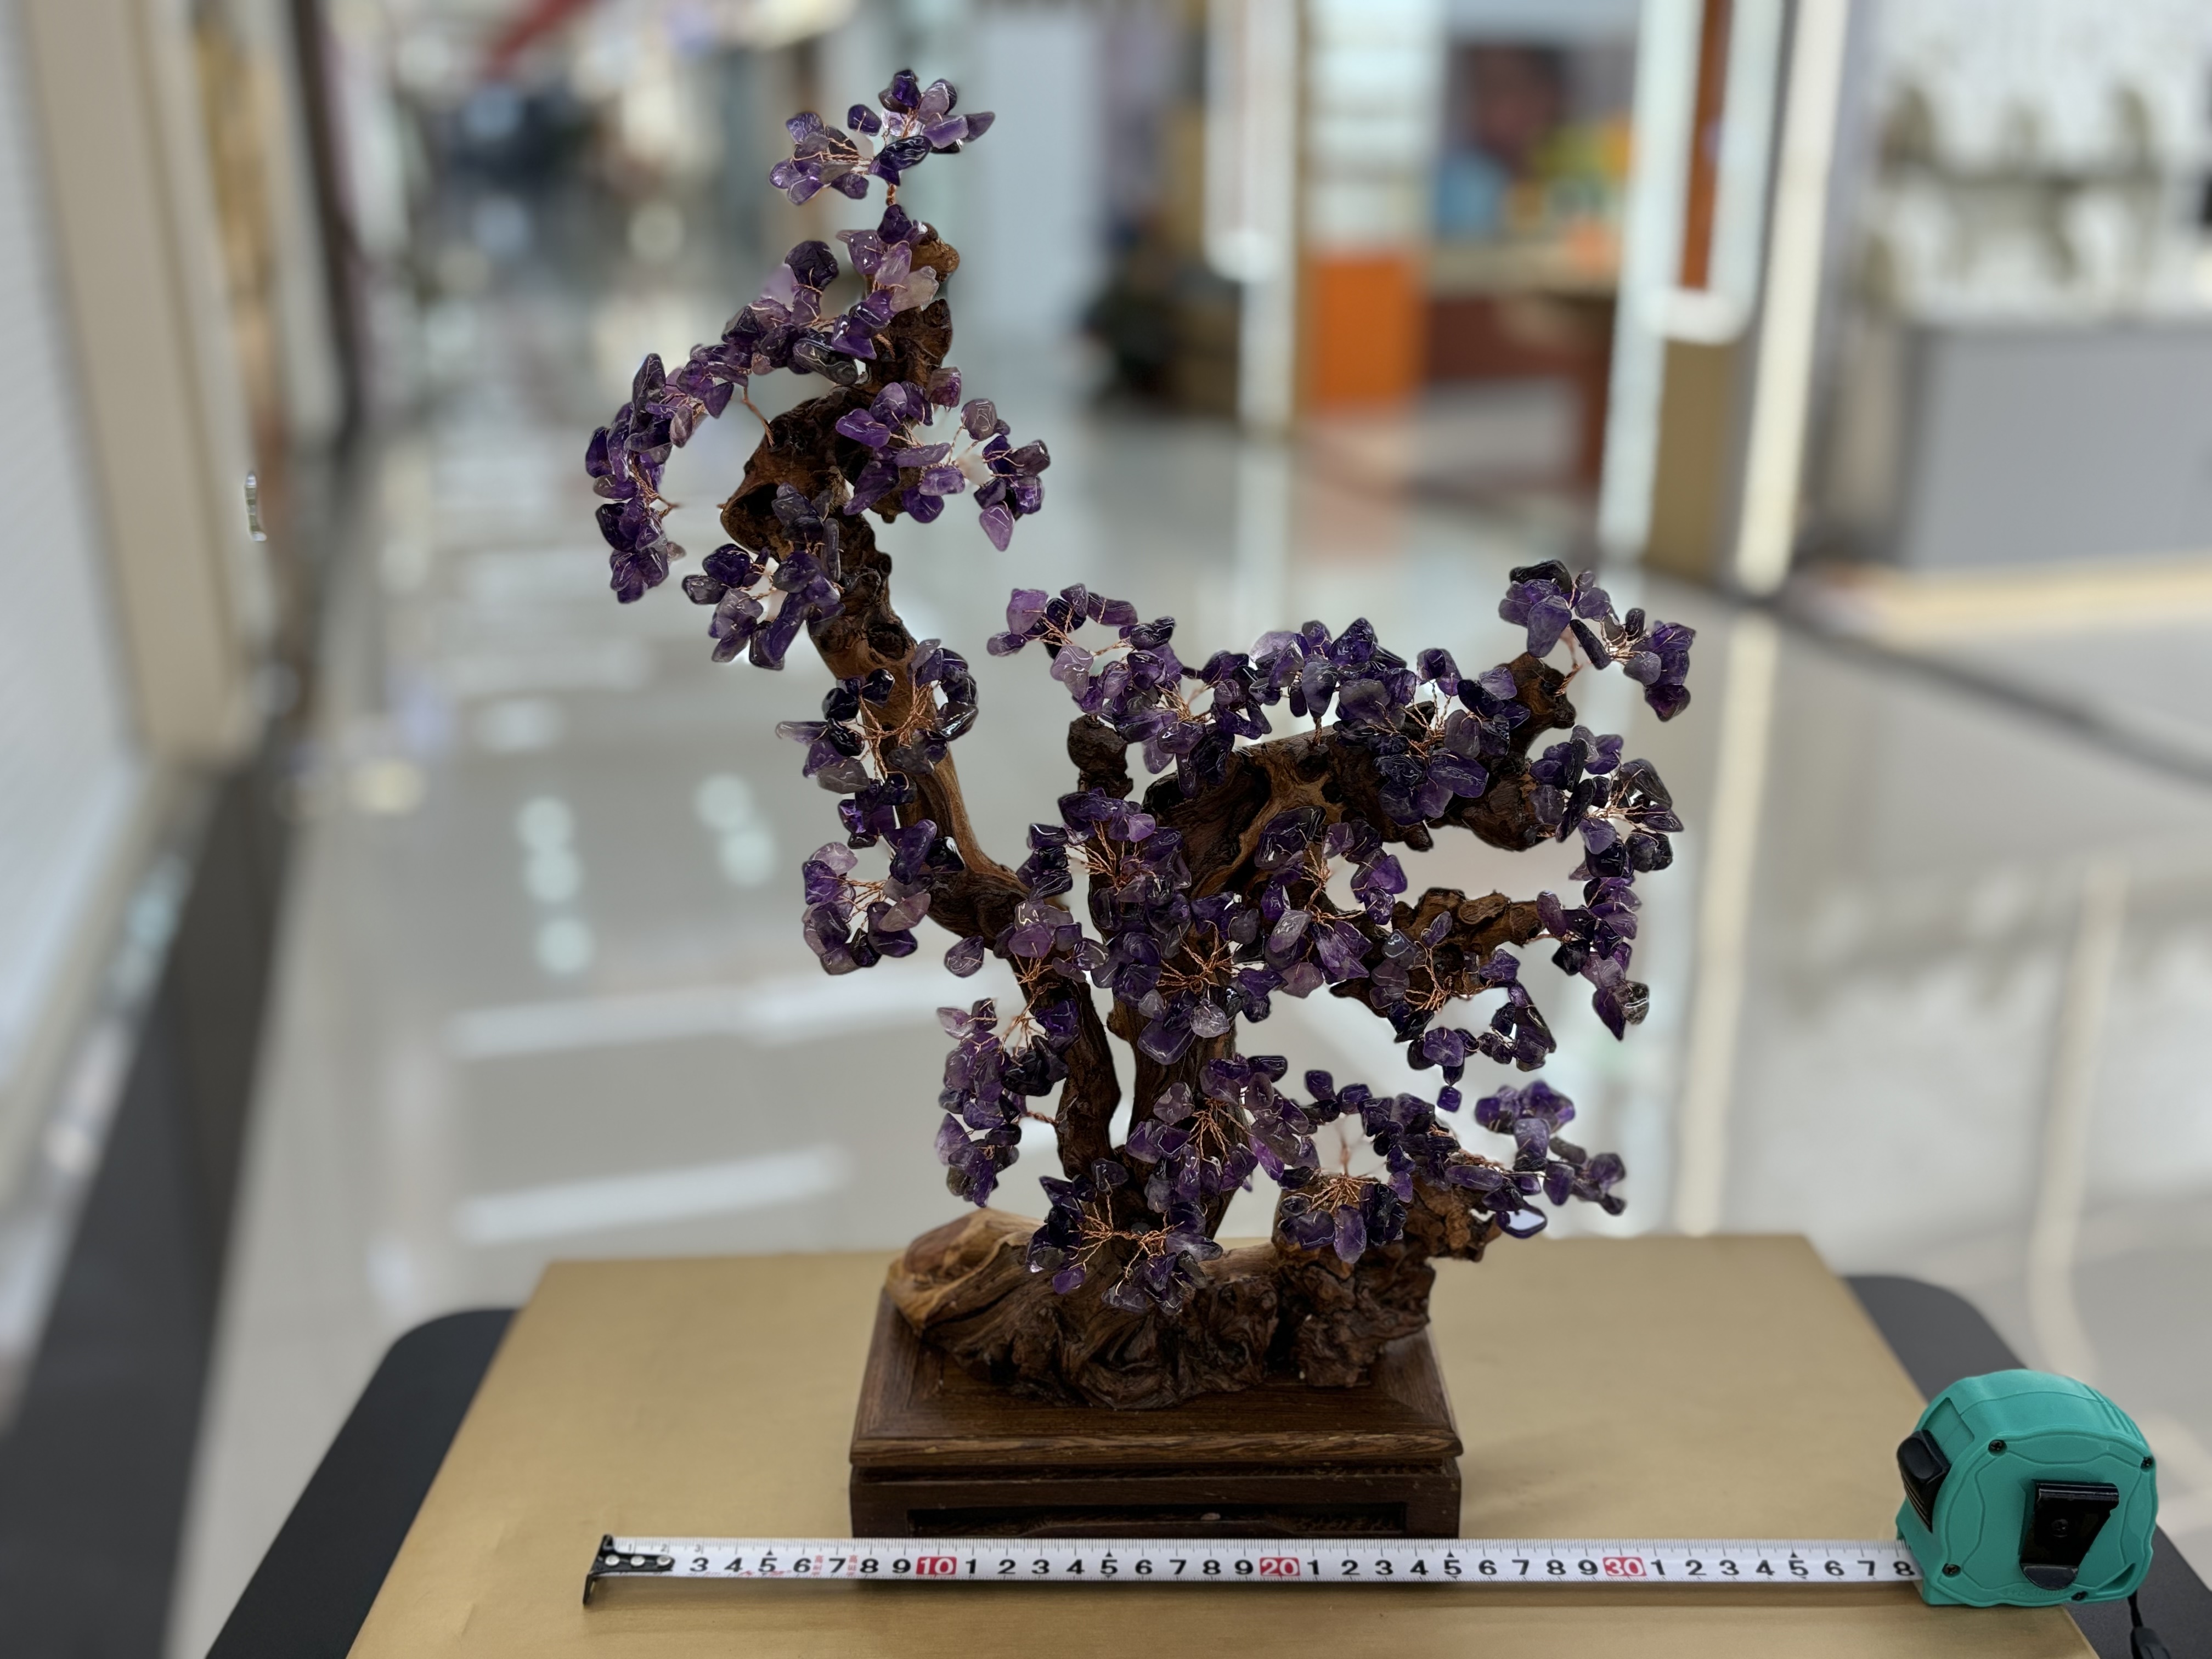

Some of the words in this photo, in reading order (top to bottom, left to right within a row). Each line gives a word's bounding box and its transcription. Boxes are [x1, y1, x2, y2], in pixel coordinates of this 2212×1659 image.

[660, 1544, 668, 1552] 2
[695, 1544, 702, 1553] 3
[690, 1558, 709, 1572] 3
[724, 1558, 743, 1572] 4
[758, 1558, 777, 1572] 5
[793, 1558, 811, 1573] 6
[828, 1558, 847, 1573] 7
[859, 1559, 879, 1573] 8
[892, 1559, 911, 1574] 9
[919, 1558, 955, 1575] 10
[965, 1559, 977, 1575] 1
[997, 1559, 1017, 1575] 2
[1031, 1559, 1050, 1575] 3
[1065, 1559, 1085, 1575] 4
[1099, 1559, 1118, 1575] 5
[1135, 1559, 1153, 1575] 6
[1169, 1559, 1187, 1575] 7
[1201, 1560, 1222, 1576] 8
[1234, 1560, 1254, 1576] 9
[1261, 1559, 1299, 1576] 20
[1307, 1560, 1320, 1576] 1
[1341, 1560, 1361, 1576] 2
[1374, 1560, 1394, 1576] 3
[1409, 1560, 1429, 1576] 4
[1443, 1560, 1463, 1576] 5
[1478, 1560, 1498, 1576] 6
[1511, 1560, 1530, 1576] 7
[1546, 1560, 1567, 1575] 8
[1578, 1560, 1599, 1576] 9
[1604, 1559, 1644, 1576] 30
[1651, 1560, 1666, 1576] 1
[1685, 1560, 1703, 1576] 2
[1719, 1560, 1740, 1576] 3
[1755, 1560, 1774, 1576] 4
[1788, 1560, 1809, 1576] 5
[1824, 1561, 1845, 1576] 6
[1857, 1560, 1876, 1576] 7
[1892, 1561, 1916, 1577] 8
